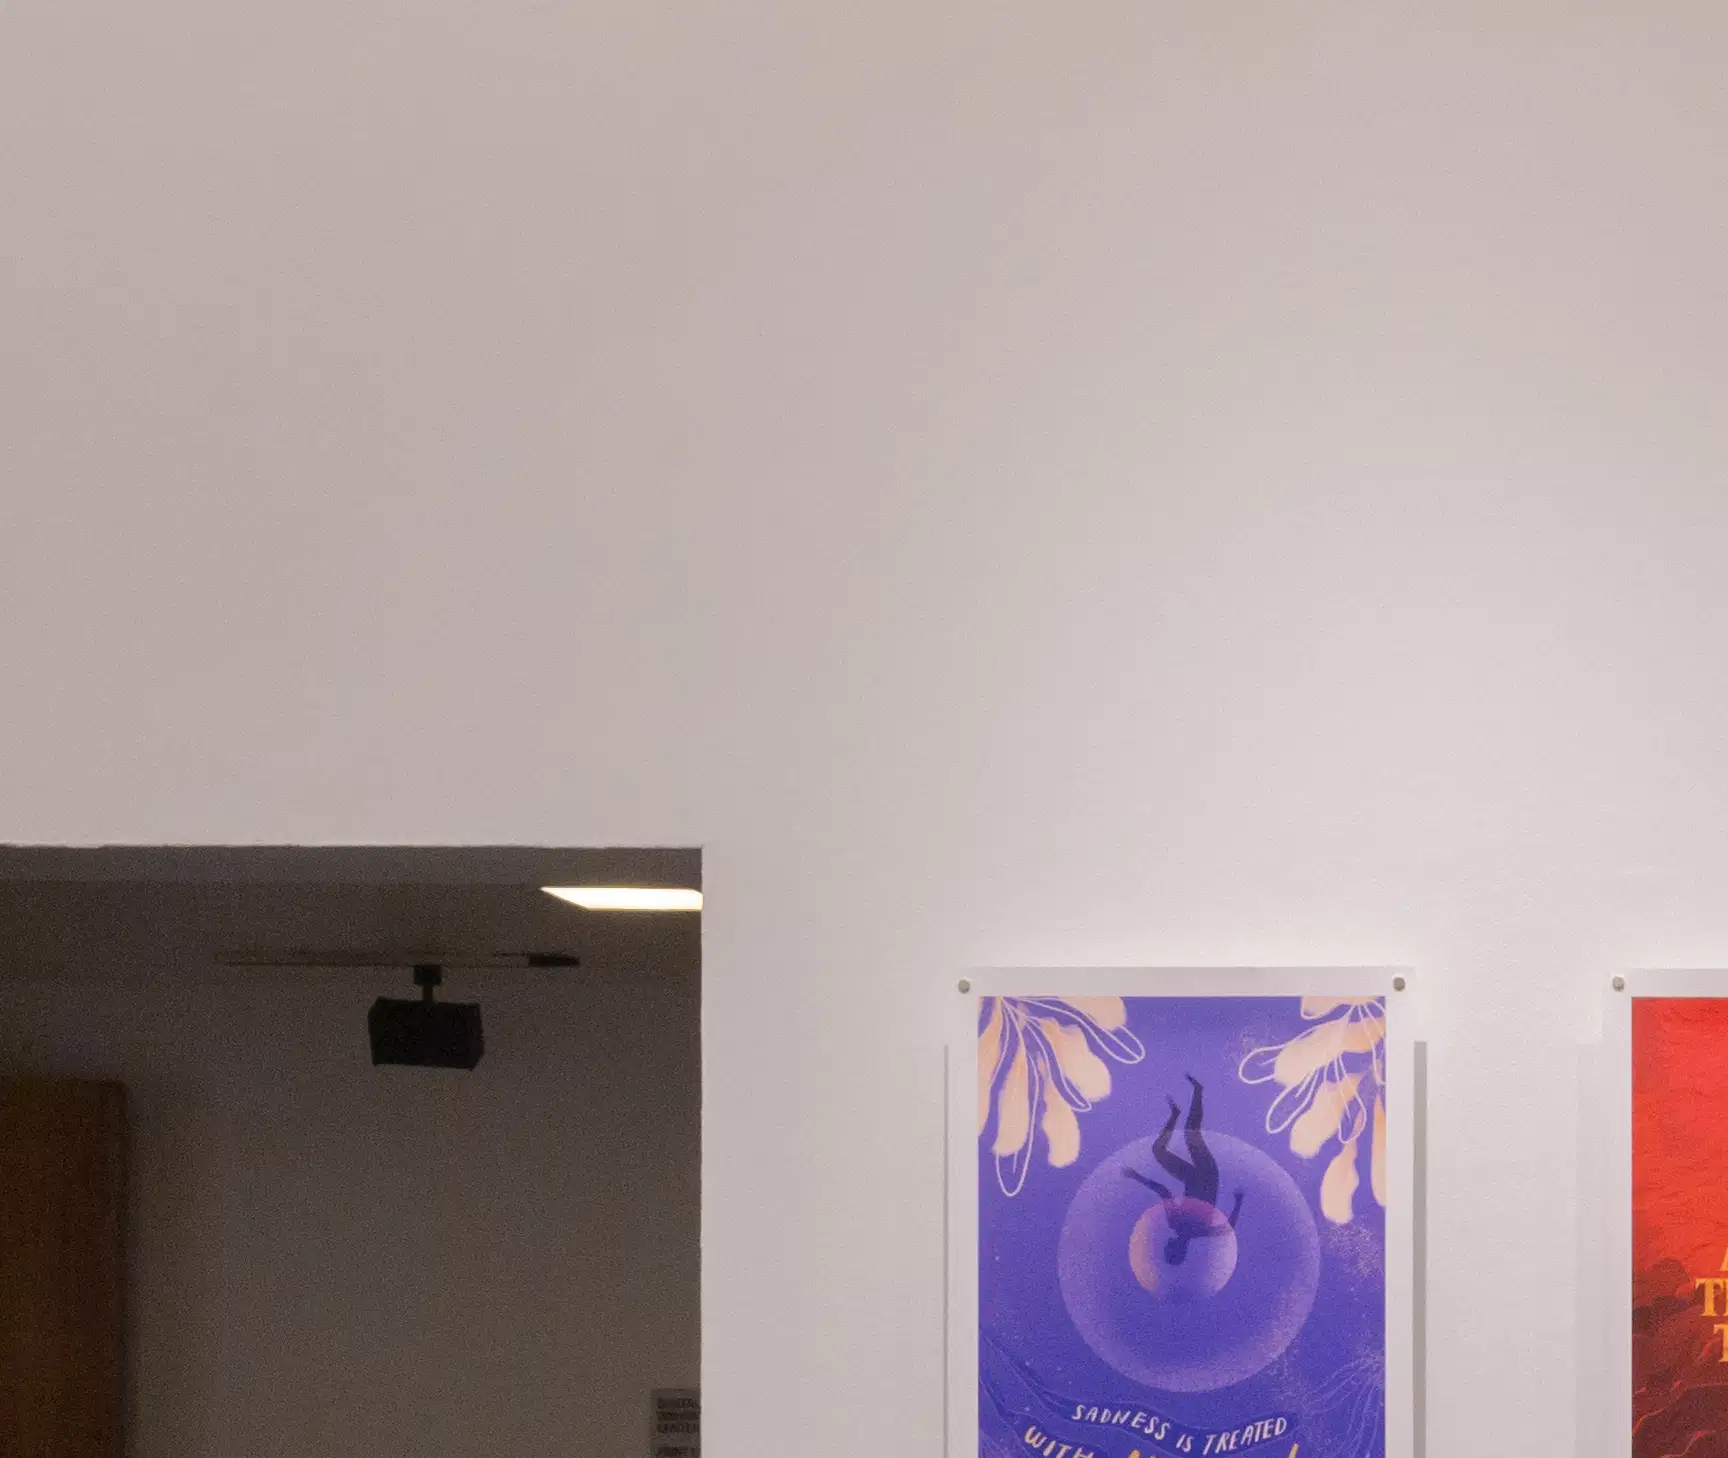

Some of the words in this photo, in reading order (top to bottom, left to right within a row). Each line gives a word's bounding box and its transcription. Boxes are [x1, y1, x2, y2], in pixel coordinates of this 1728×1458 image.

[1071, 1404, 1172, 1441] SADNESS
[1176, 1433, 1194, 1453] IS
[1200, 1417, 1288, 1456] TREATED
